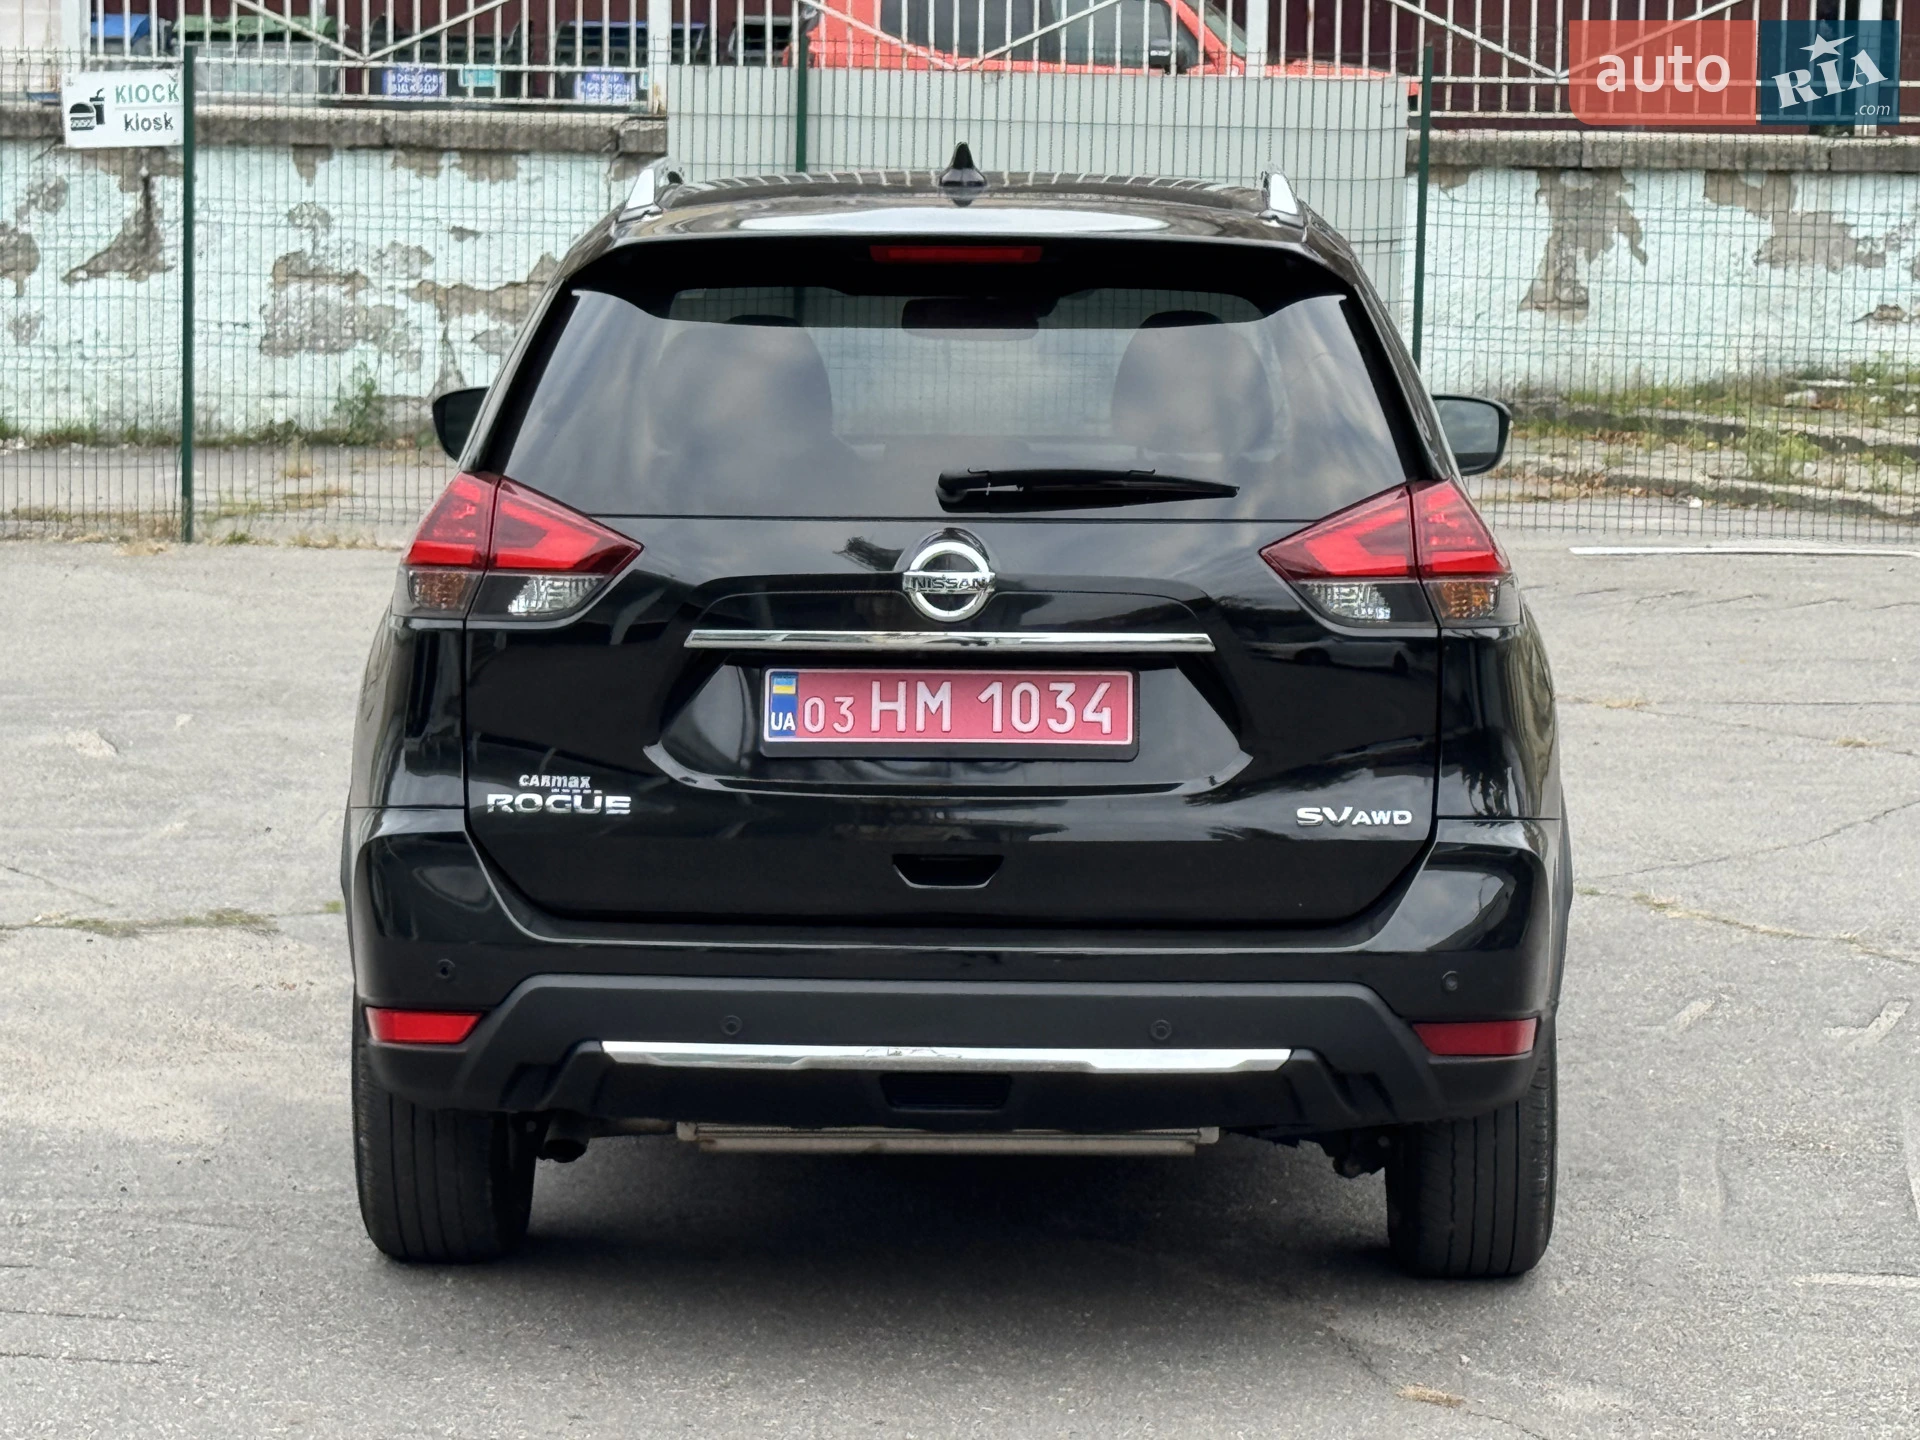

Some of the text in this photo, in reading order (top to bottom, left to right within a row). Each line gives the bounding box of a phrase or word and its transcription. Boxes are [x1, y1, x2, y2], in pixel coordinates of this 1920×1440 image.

[124, 112, 174, 132] kiosk
[911, 576, 988, 589] NISSAN
[803, 680, 1112, 734] 03 HM 1034
[771, 711, 796, 731] UA
[486, 793, 632, 815] ROGUE
